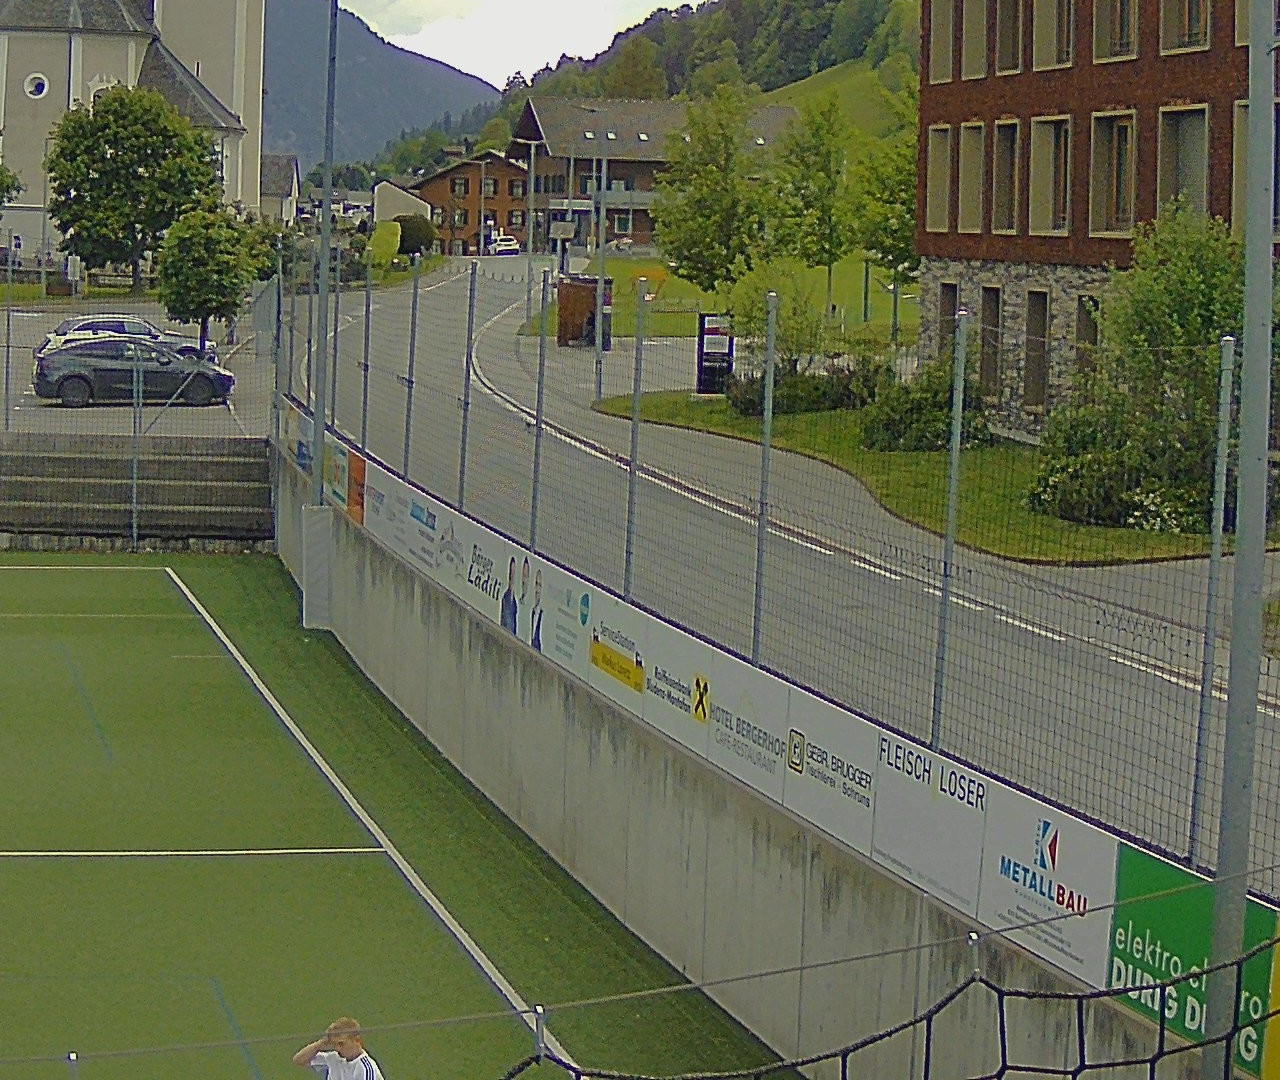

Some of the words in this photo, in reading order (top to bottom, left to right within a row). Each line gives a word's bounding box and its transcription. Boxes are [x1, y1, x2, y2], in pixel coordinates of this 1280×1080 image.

[710, 702, 734, 731] HOTEL
[736, 717, 787, 758] BERGERHOF
[831, 755, 872, 790] BRUGGER
[842, 782, 871, 808] Schruns
[879, 737, 932, 785] FLEISCH
[939, 765, 986, 812] LOSER
[1000, 855, 1088, 917] METALLBAU
[1115, 920, 1182, 977] elektro
[1189, 957, 1263, 1019] elro
